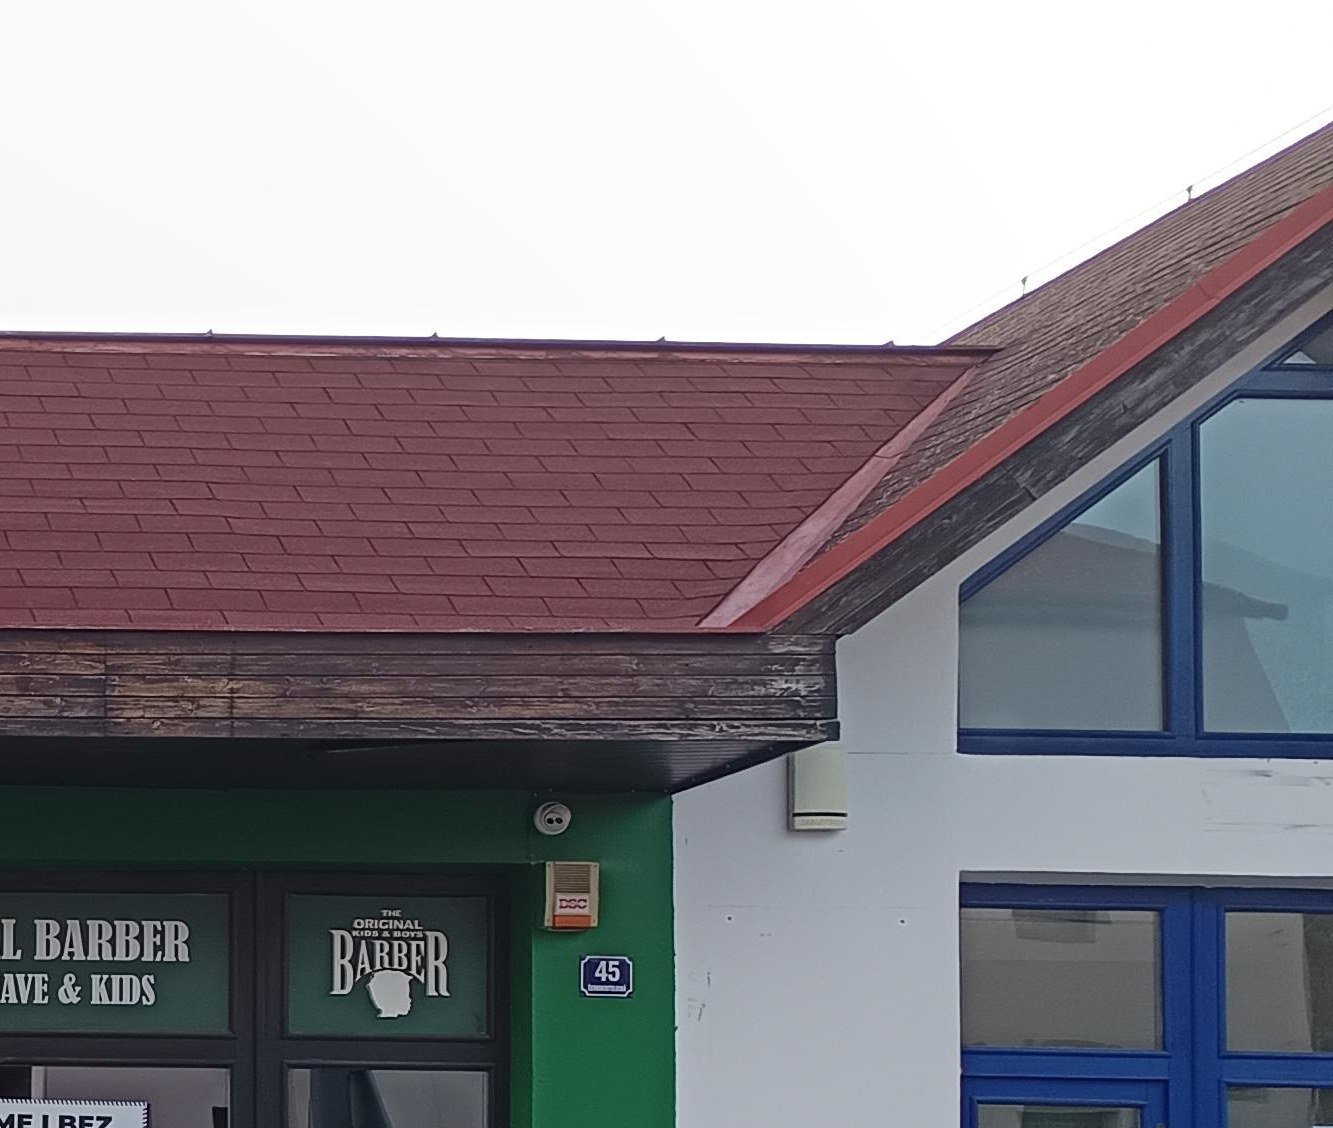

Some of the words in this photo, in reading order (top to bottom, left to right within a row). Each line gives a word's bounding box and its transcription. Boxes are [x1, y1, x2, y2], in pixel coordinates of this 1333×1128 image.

[559, 898, 587, 909] DSC
[353, 919, 423, 929] ORIGINAL
[33, 919, 191, 962] BARBER
[329, 929, 450, 997] BARBER
[595, 960, 620, 982] 45
[57, 974, 81, 1004] &
[91, 974, 155, 1006] KIDS
